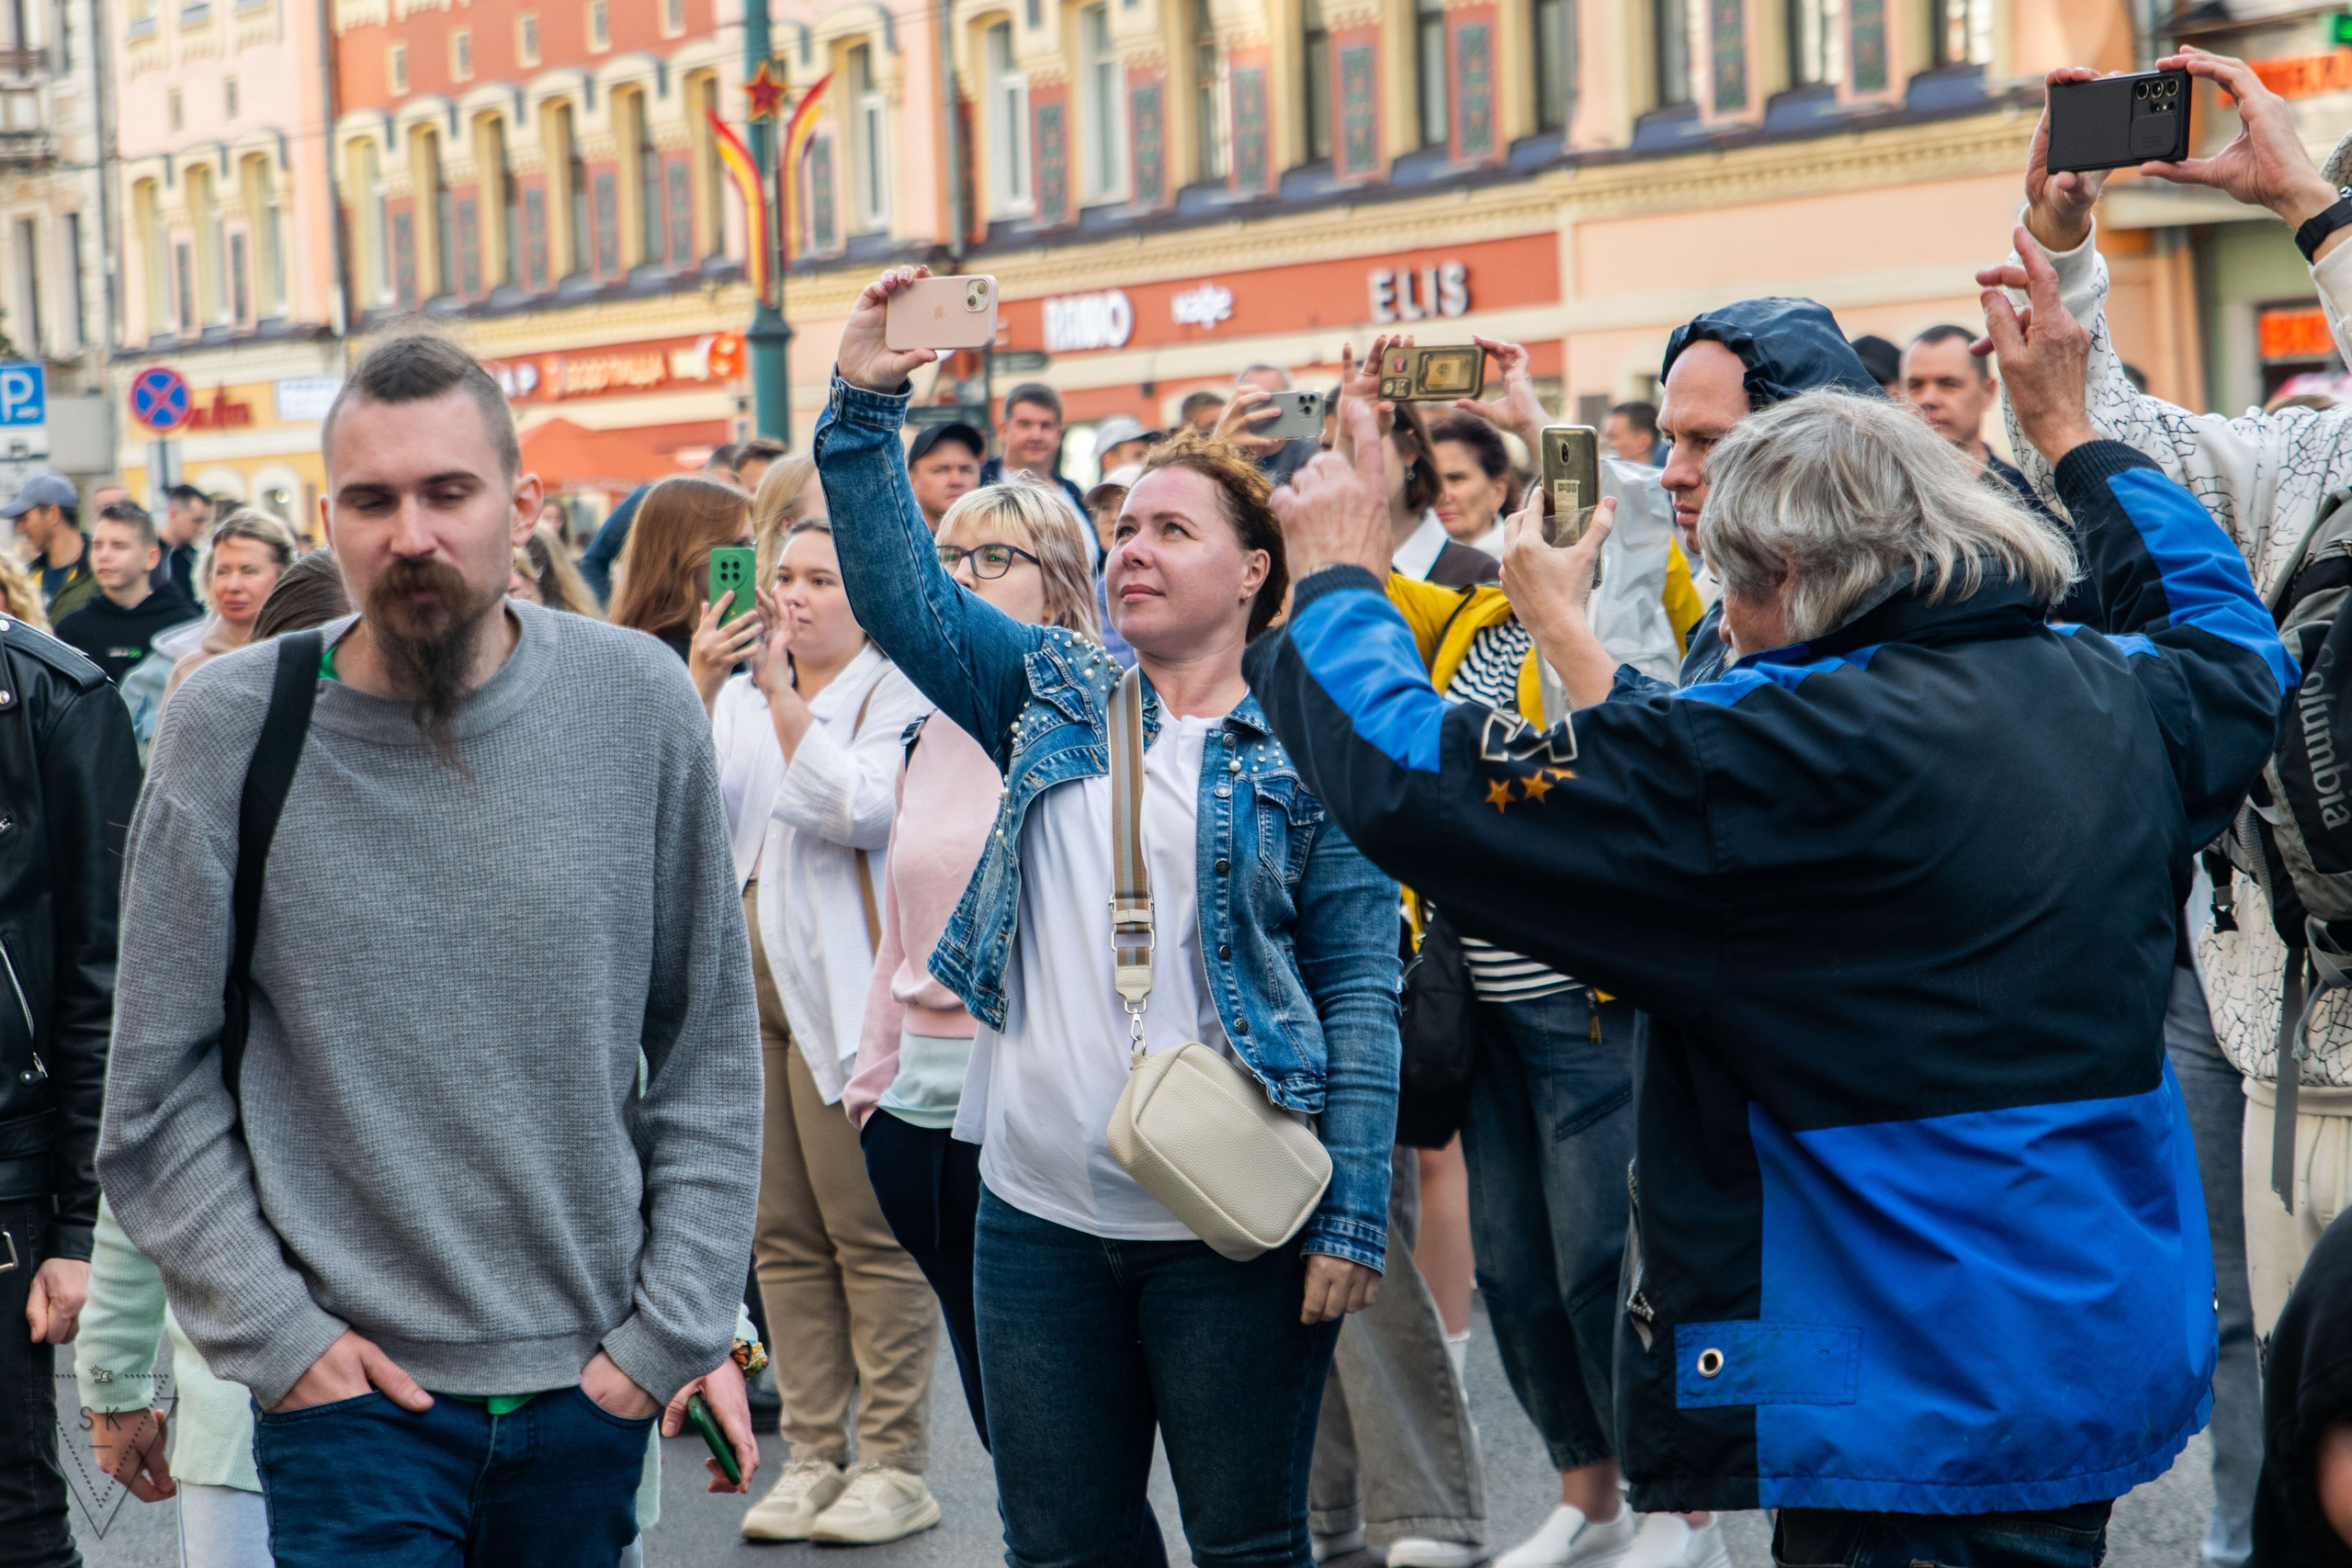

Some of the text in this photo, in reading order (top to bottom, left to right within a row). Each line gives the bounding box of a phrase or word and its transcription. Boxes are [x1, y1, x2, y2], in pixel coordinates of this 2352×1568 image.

[1368, 259, 1470, 323] ELIS
[1, 370, 34, 423] P
[2299, 644, 2351, 830] Columbia
